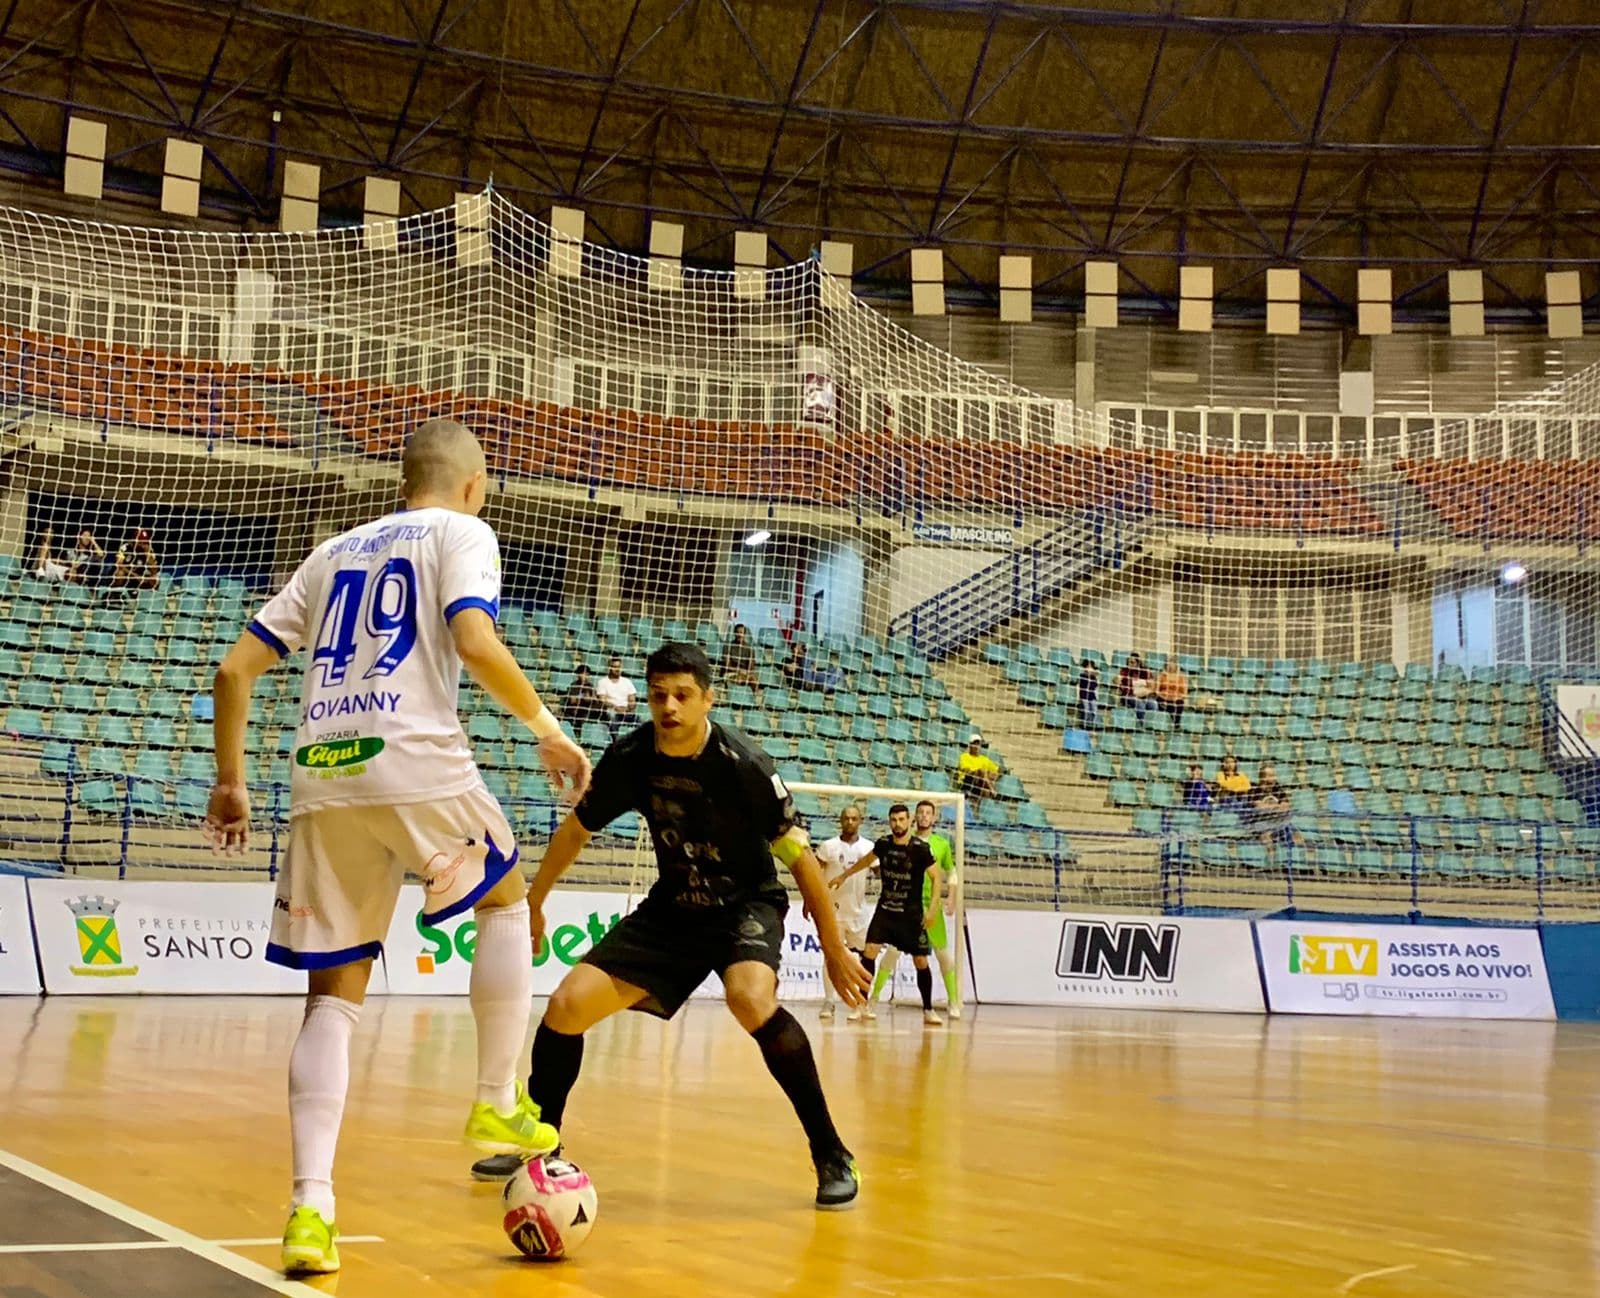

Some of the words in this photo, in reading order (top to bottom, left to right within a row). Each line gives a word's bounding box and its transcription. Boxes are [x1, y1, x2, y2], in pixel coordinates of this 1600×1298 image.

[310, 557, 417, 688] 49
[315, 729, 360, 742] PIZZARIA
[306, 740, 361, 767] Gigui
[138, 918, 270, 931] PREFEITURA
[143, 934, 253, 959] SANTO
[1057, 921, 1180, 982] INN
[1318, 942, 1371, 971] TV
[1387, 942, 1461, 957] ASSISTA
[1465, 944, 1501, 958] AOS
[1390, 963, 1451, 977] JOGOS
[1455, 964, 1480, 977] AO
[1482, 964, 1533, 978] VIVO!
[1382, 989, 1501, 1001] tv.ligafutsal.com.br
